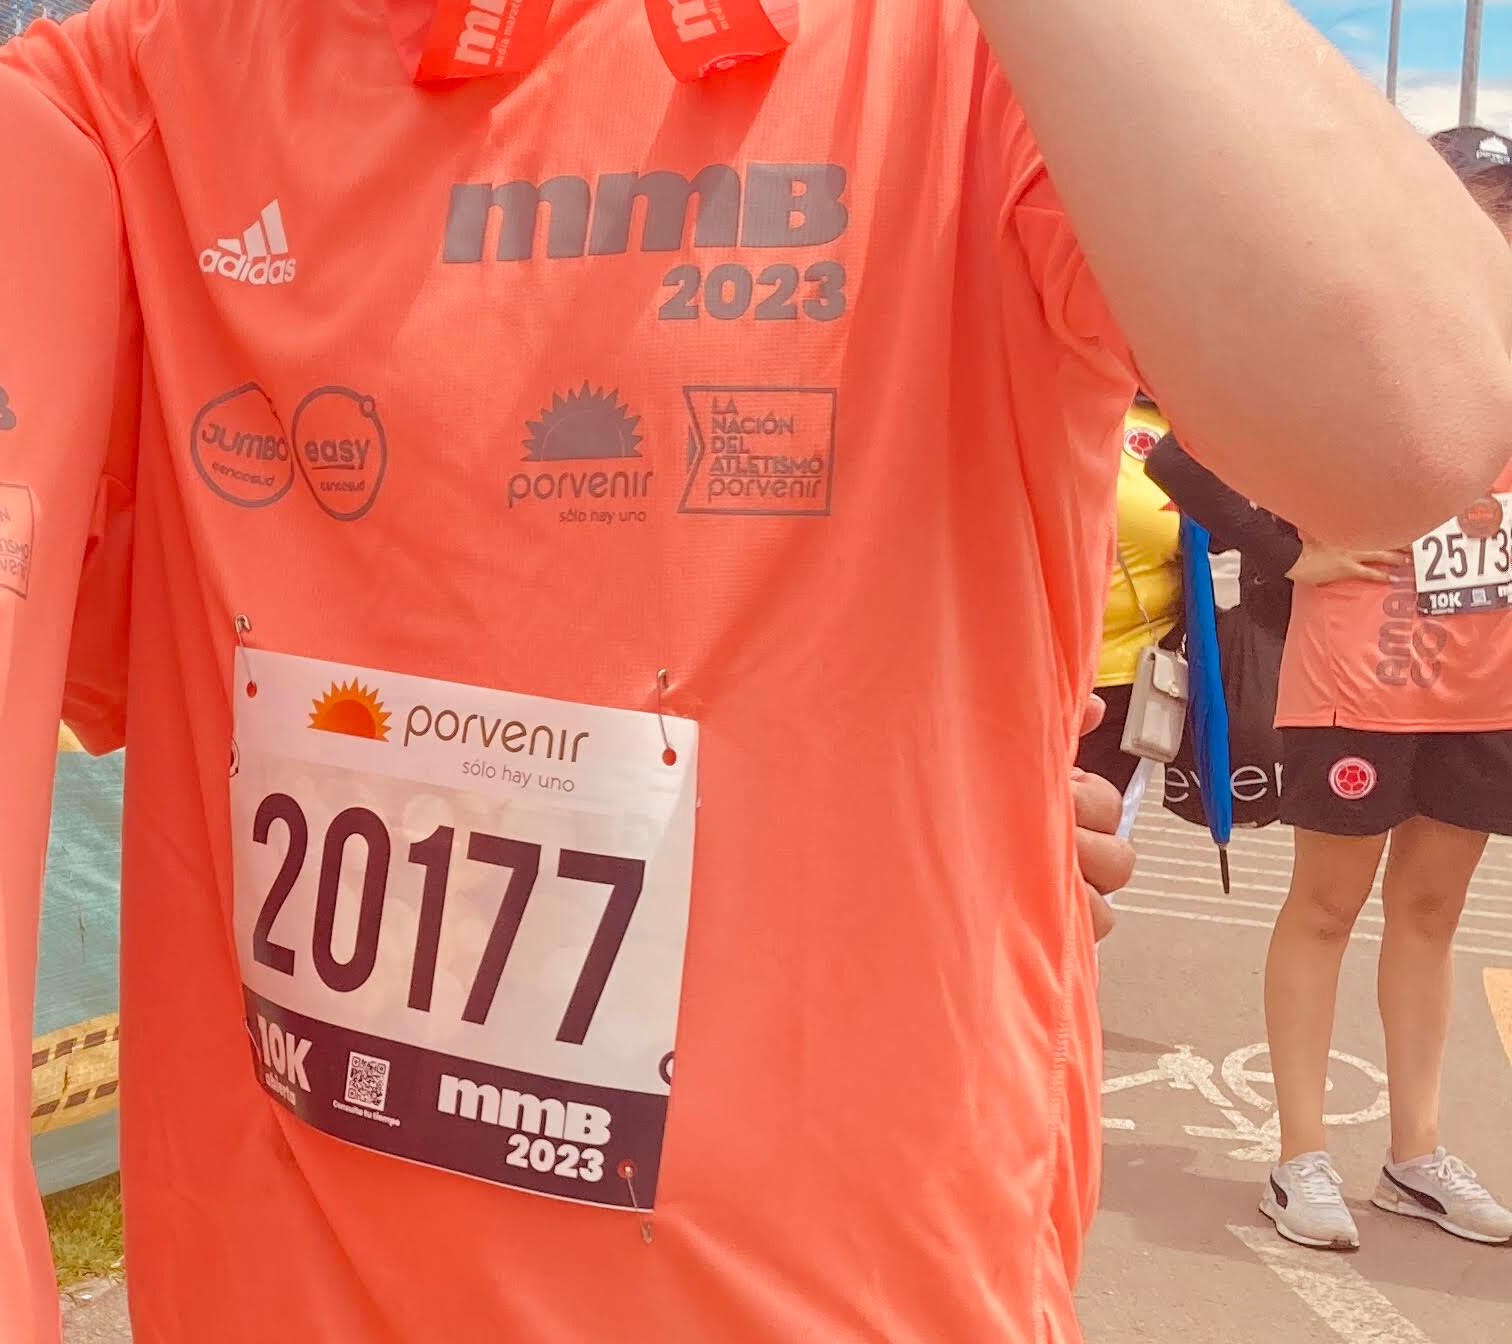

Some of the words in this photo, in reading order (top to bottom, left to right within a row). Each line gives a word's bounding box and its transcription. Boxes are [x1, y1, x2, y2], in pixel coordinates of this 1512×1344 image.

[442, 163, 849, 264] mmB
[199, 244, 297, 285] adidas
[658, 261, 846, 321] 2023
[711, 396, 737, 414] LA
[711, 412, 794, 435] NACIÓN
[304, 438, 371, 470] easy
[711, 436, 750, 454] DEL
[710, 455, 824, 475] ATLETISMO
[508, 470, 653, 508] porvenir
[708, 477, 822, 503] porvenir
[1429, 591, 1463, 609] 10K
[403, 704, 590, 763] porvenir
[462, 759, 497, 780] sólo
[502, 764, 533, 790] hay
[538, 773, 576, 794] uno
[252, 792, 646, 1046] 20177
[257, 1013, 313, 1093] 10K
[438, 1075, 611, 1146] mmB
[506, 1133, 605, 1183] 2023
